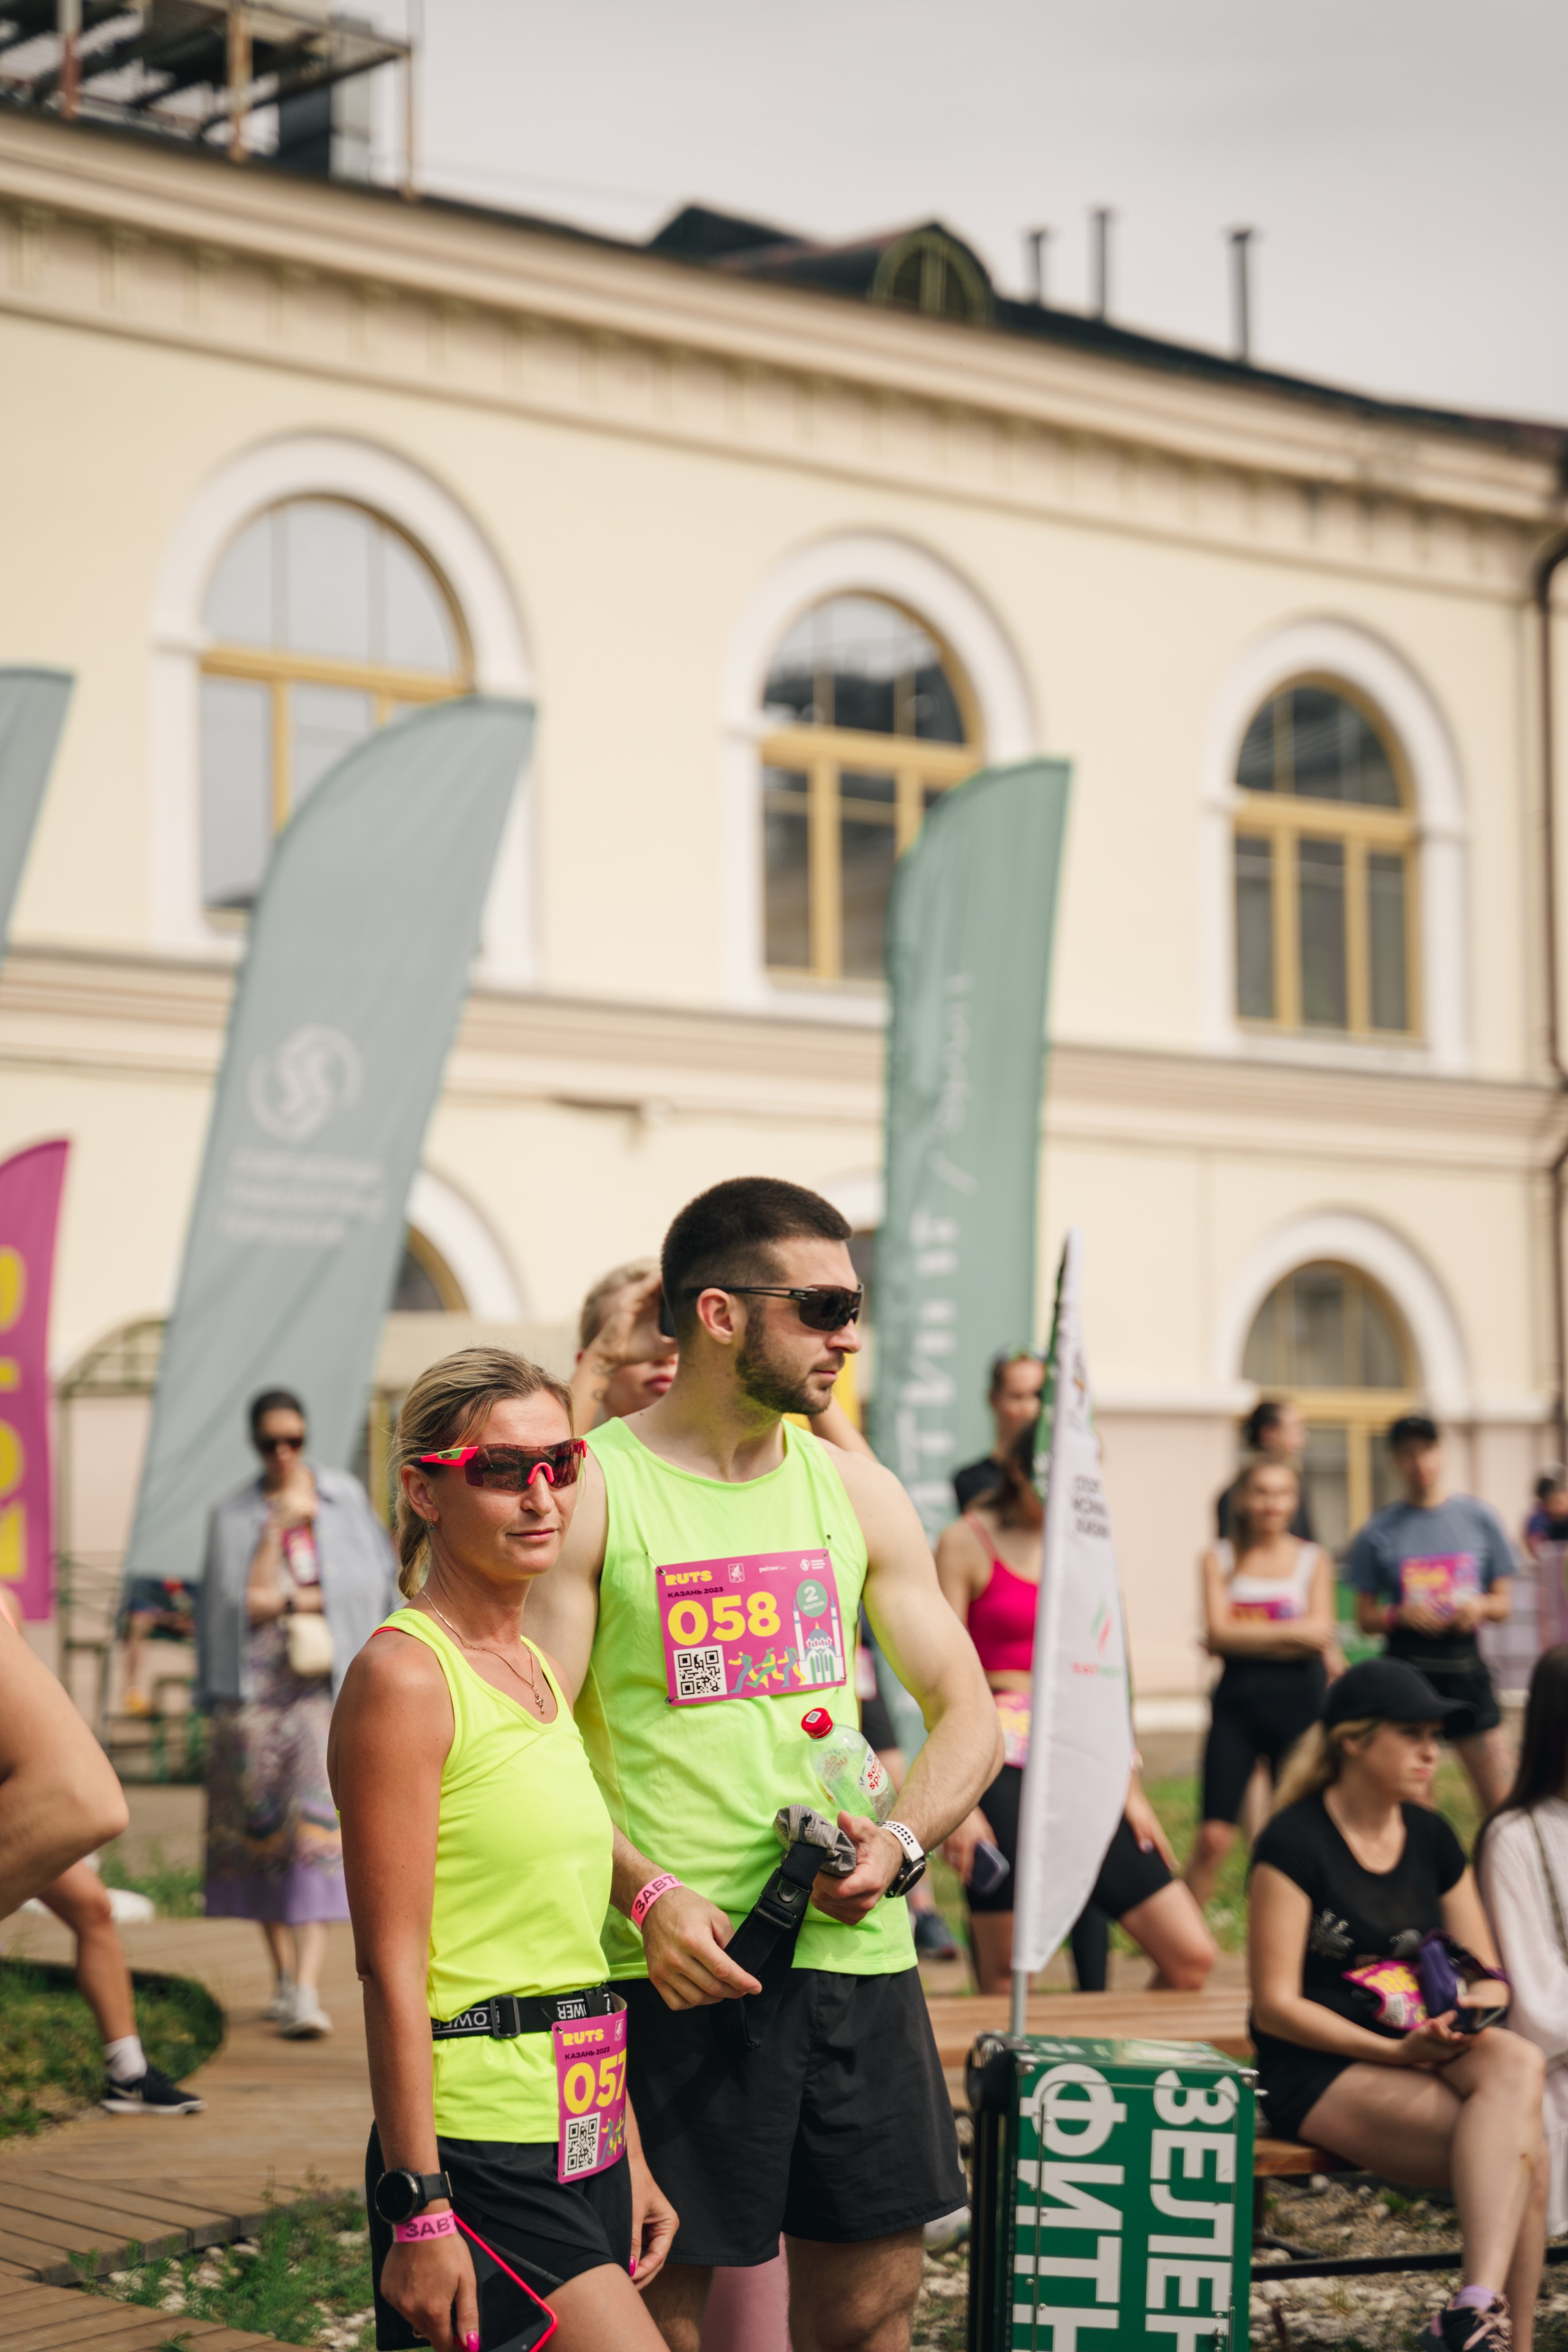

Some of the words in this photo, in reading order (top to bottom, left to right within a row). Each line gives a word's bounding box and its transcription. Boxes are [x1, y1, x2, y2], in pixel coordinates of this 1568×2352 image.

[665, 1570, 712, 1586] RUTS
[668, 1589, 703, 1598] КАЗАНЬ
[804, 1586, 819, 1603] 2
[668, 1591, 781, 1646] 058
[557, 2003, 587, 2020] WER
[562, 2028, 604, 2046] RUTS
[565, 2050, 595, 2059] КАЗАНЬ
[595, 2046, 610, 2055] 2023
[564, 2048, 627, 2114] 057
